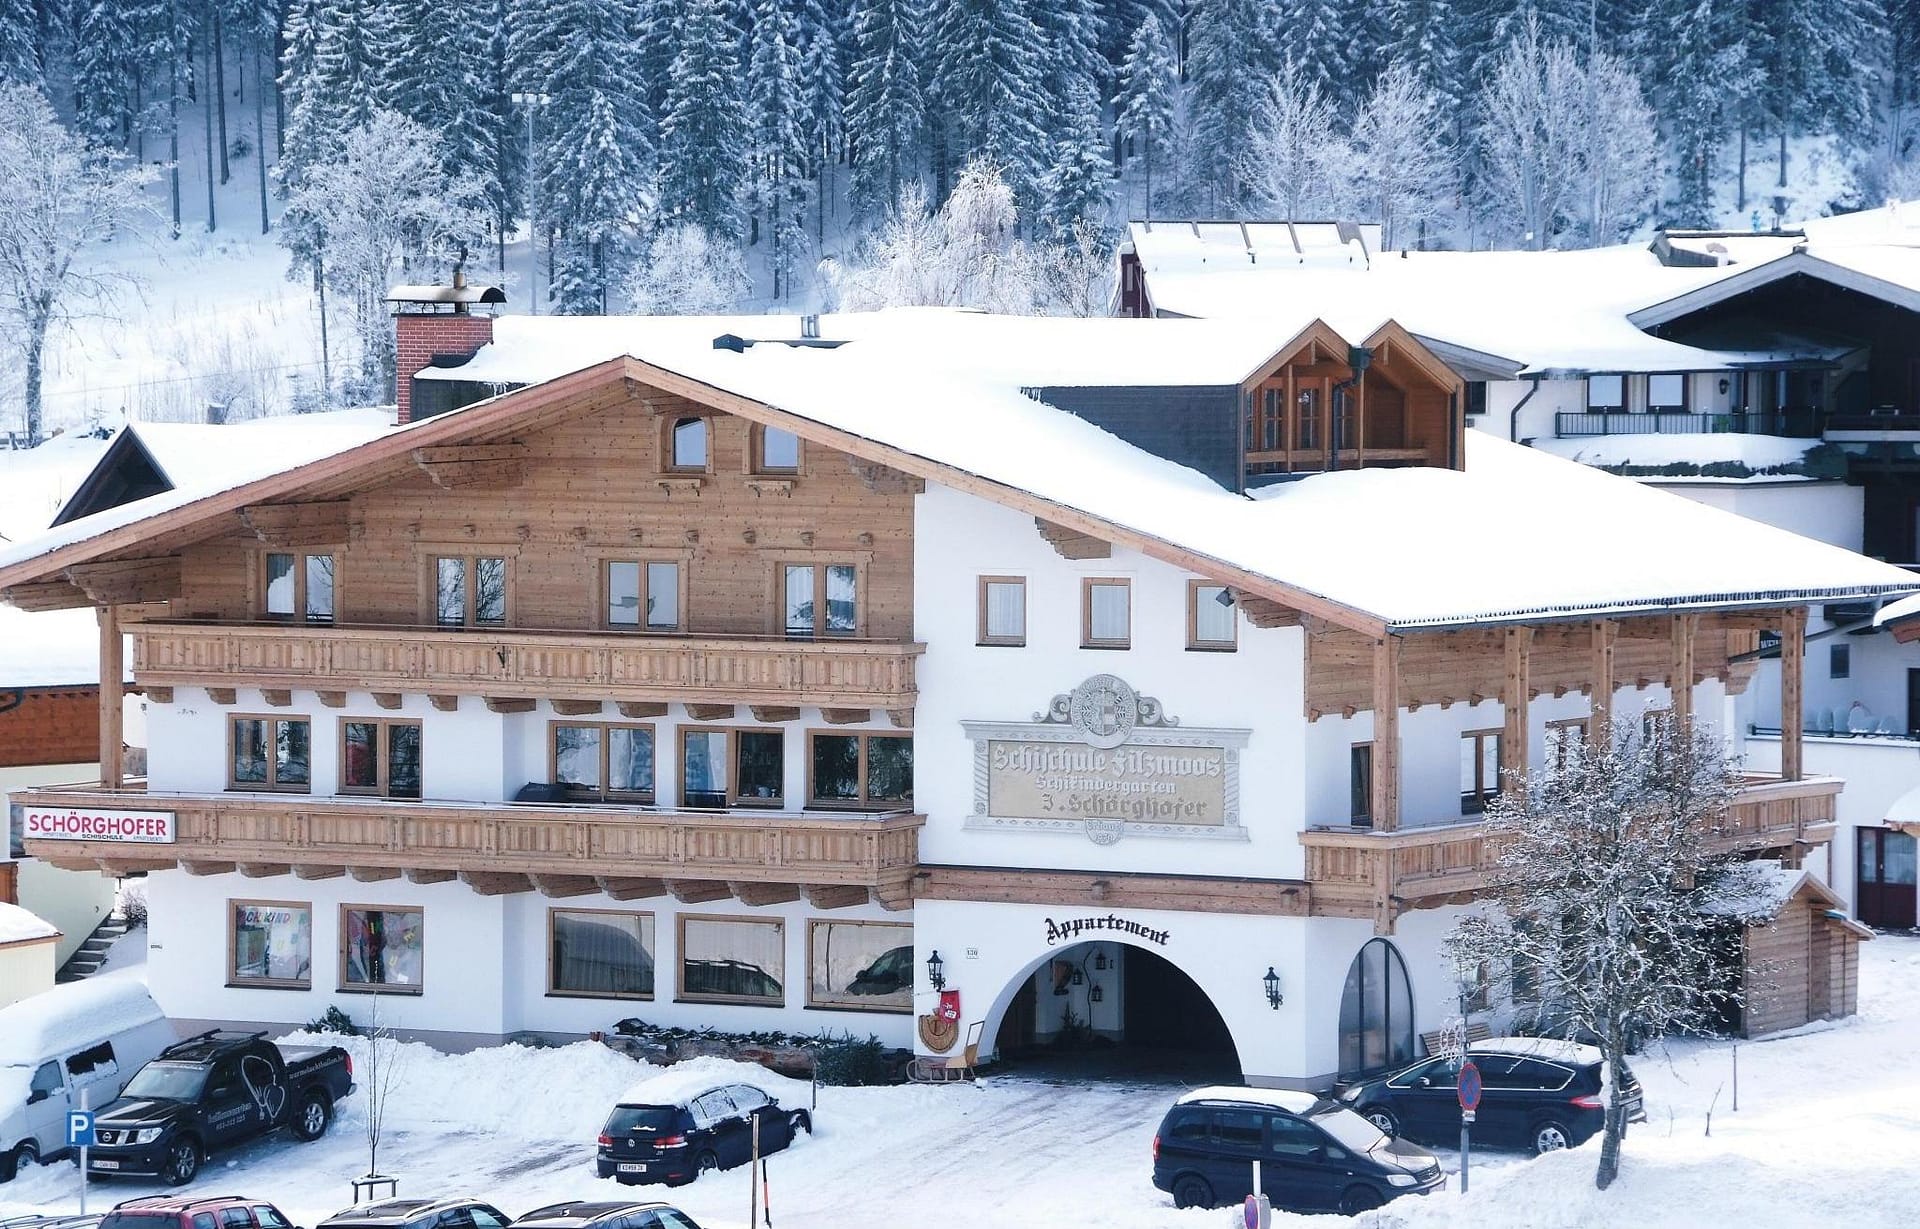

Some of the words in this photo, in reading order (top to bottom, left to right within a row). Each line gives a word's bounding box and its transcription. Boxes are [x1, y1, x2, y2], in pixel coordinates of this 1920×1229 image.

[1111, 750, 1221, 778] Filzmoos
[1068, 793, 1208, 821] Schörghofer
[29, 811, 166, 836] SCHÖRGHOFER
[1045, 913, 1170, 945] Appartement
[71, 1115, 89, 1142] P
